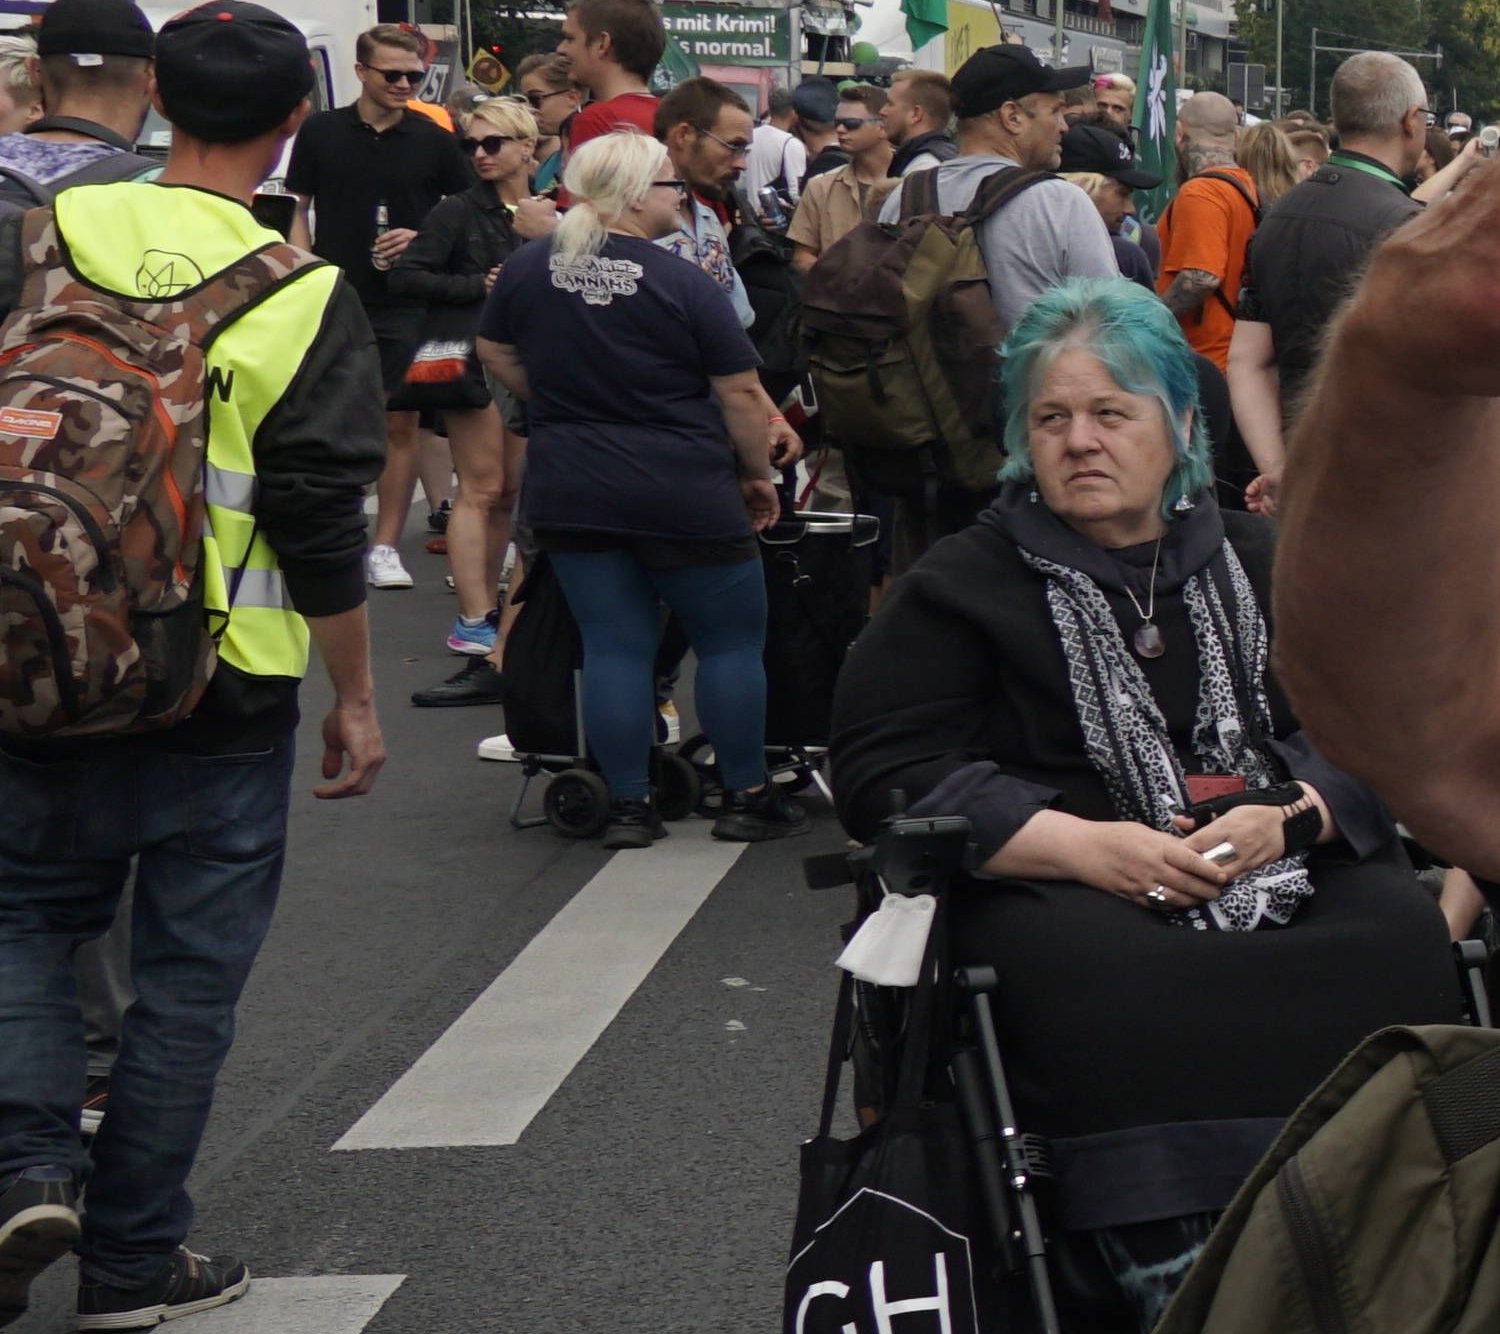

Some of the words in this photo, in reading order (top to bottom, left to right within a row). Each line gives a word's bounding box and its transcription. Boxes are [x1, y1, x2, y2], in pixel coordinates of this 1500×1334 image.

[677, 14, 711, 31] mit
[716, 14, 776, 33] Krimi!
[695, 38, 776, 57] normal.
